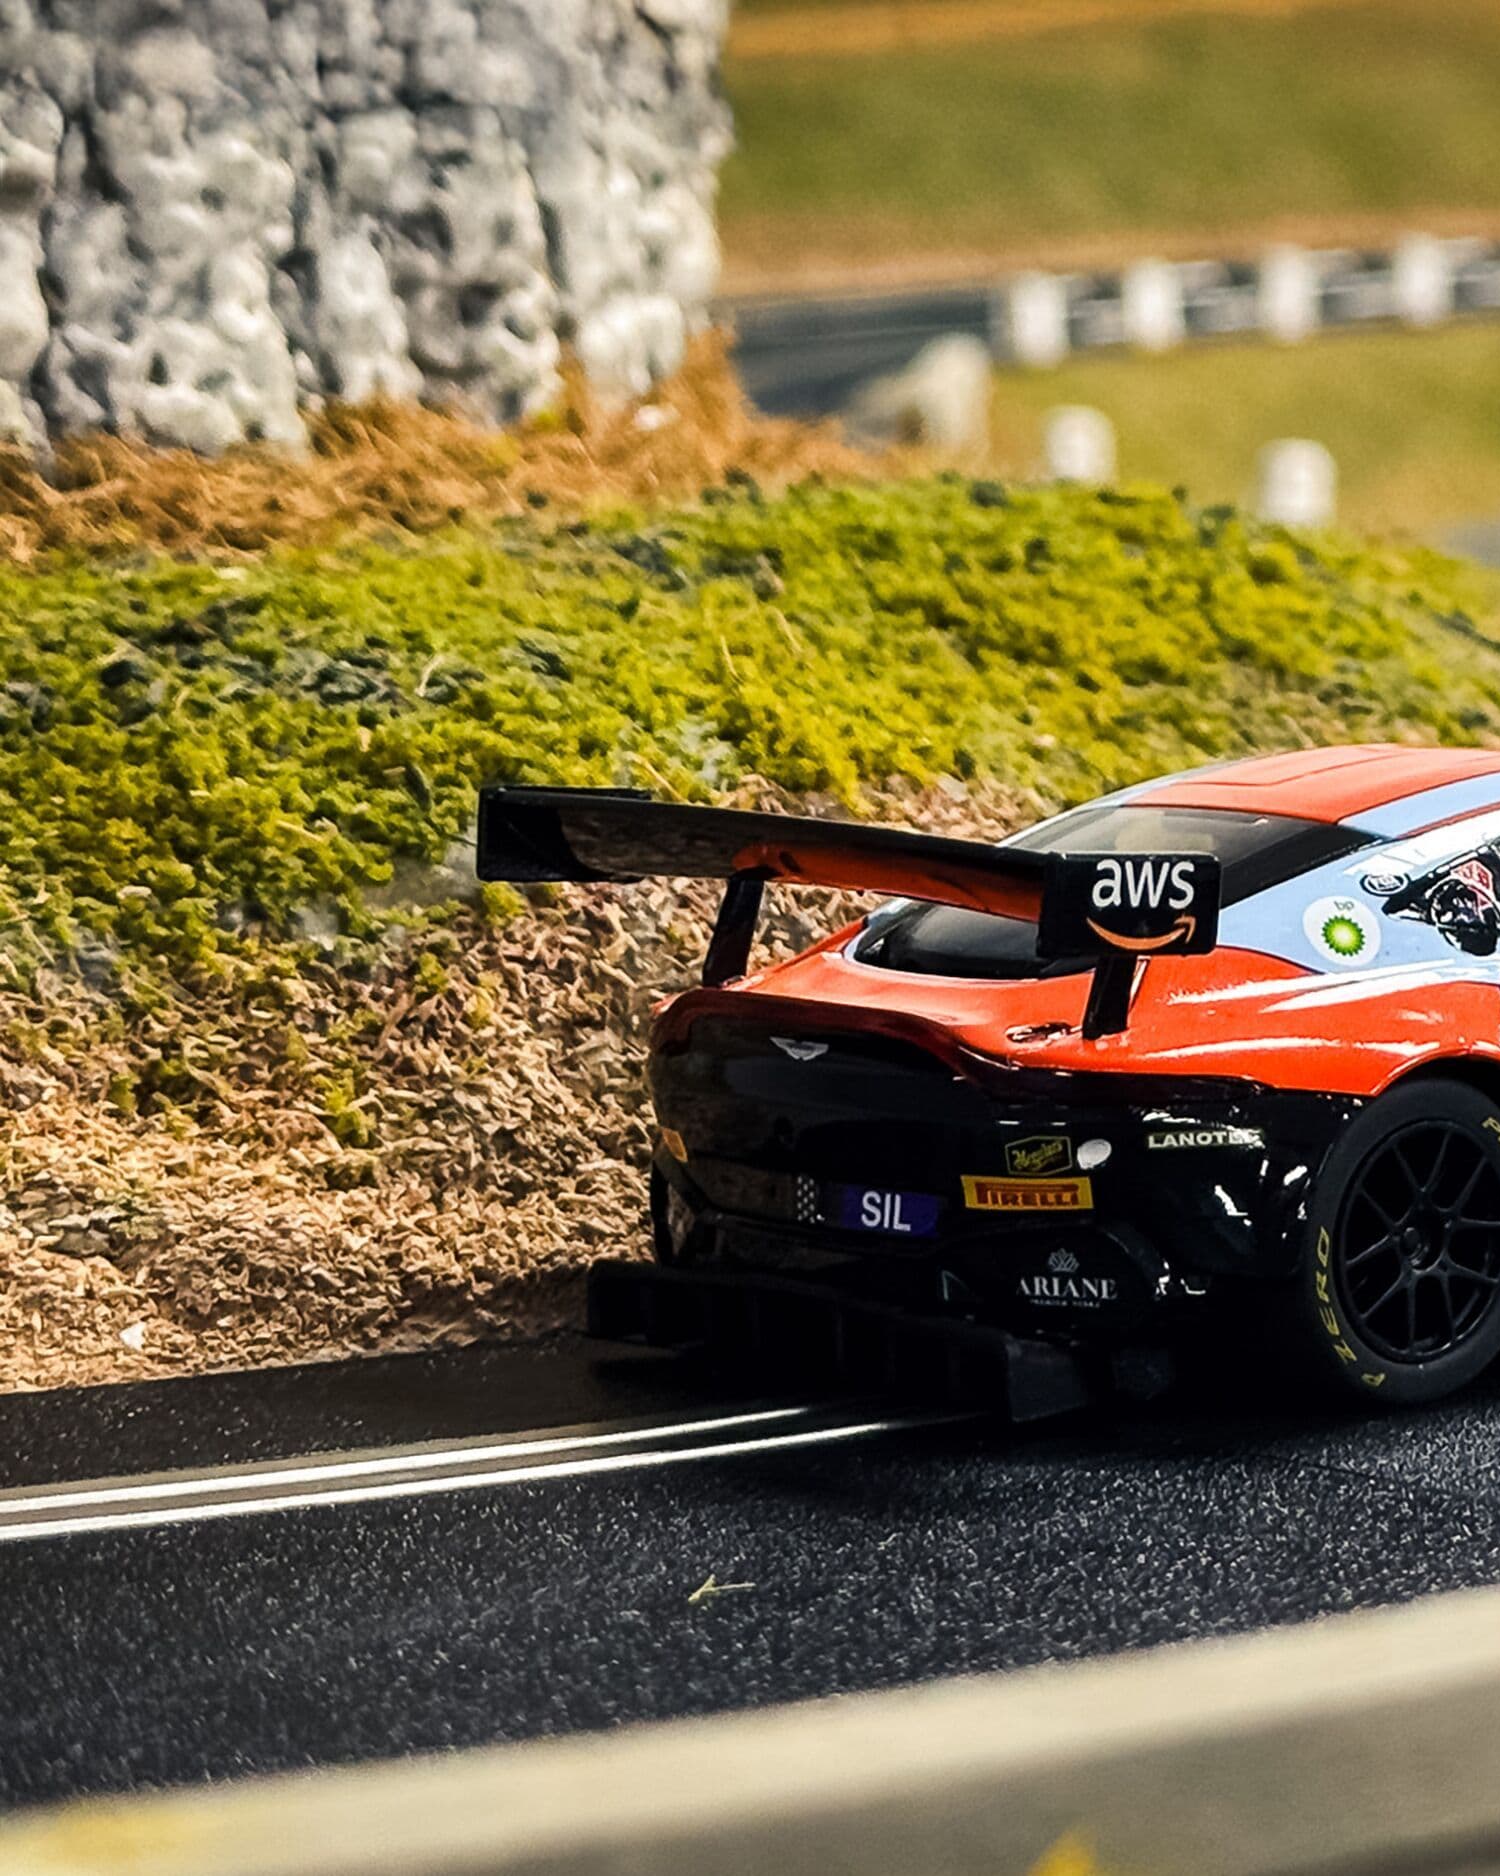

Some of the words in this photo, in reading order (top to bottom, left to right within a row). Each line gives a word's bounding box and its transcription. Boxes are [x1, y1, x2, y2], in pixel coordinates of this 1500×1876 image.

[1092, 859, 1195, 911] aws
[1333, 900, 1355, 912] bp
[975, 1182, 1079, 1206] PIRELLI
[861, 1190, 912, 1232] SIL
[1016, 1275, 1118, 1299] ARIANE
[1316, 1226, 1357, 1365] ZERO
